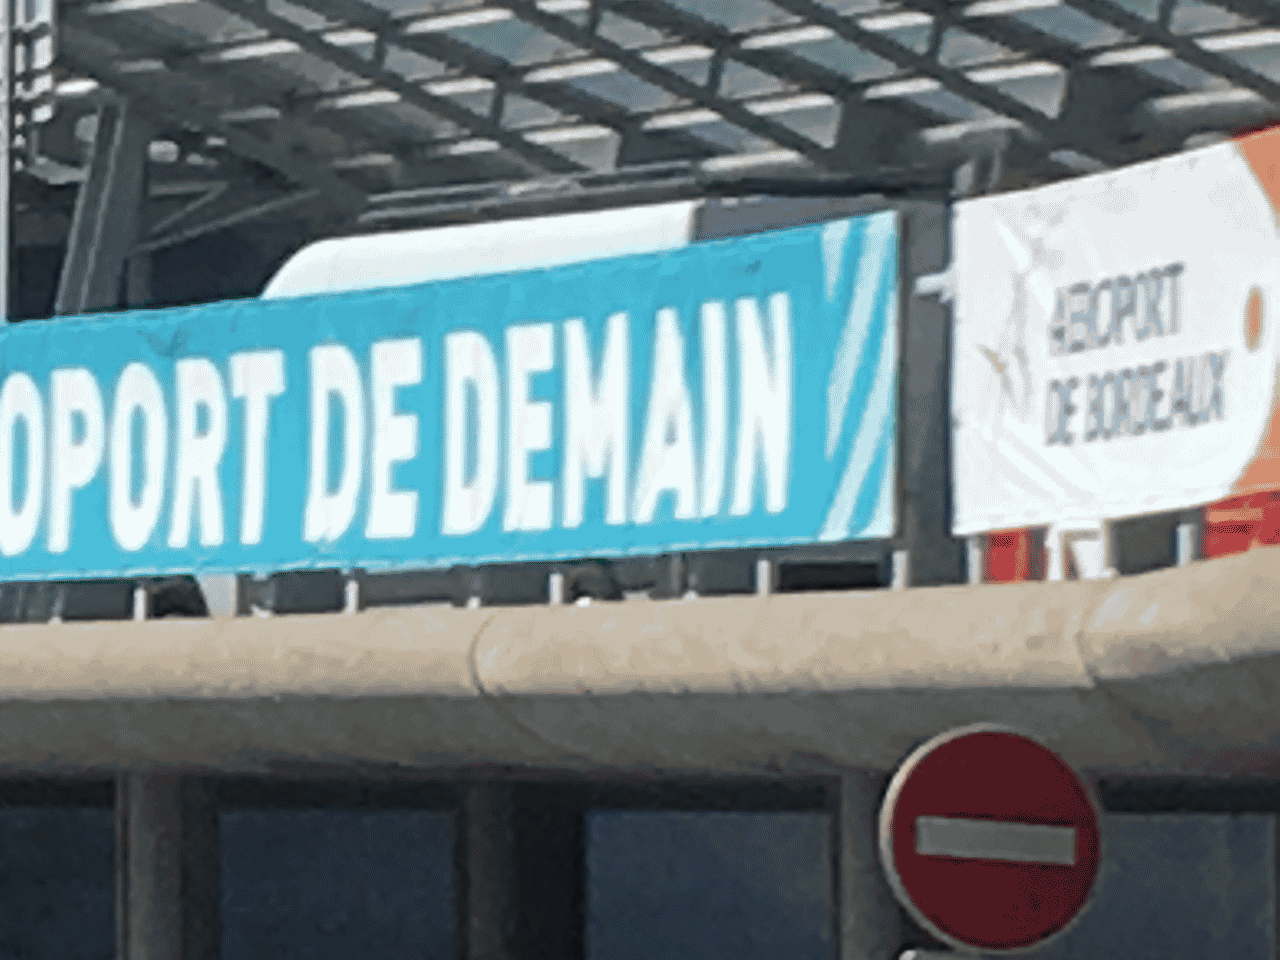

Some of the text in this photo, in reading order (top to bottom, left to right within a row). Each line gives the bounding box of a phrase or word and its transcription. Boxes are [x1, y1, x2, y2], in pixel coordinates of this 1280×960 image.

[302, 336, 424, 544] DE
[441, 291, 791, 536] DEMAIN
[1044, 349, 1233, 447] DE BORDEAUX
